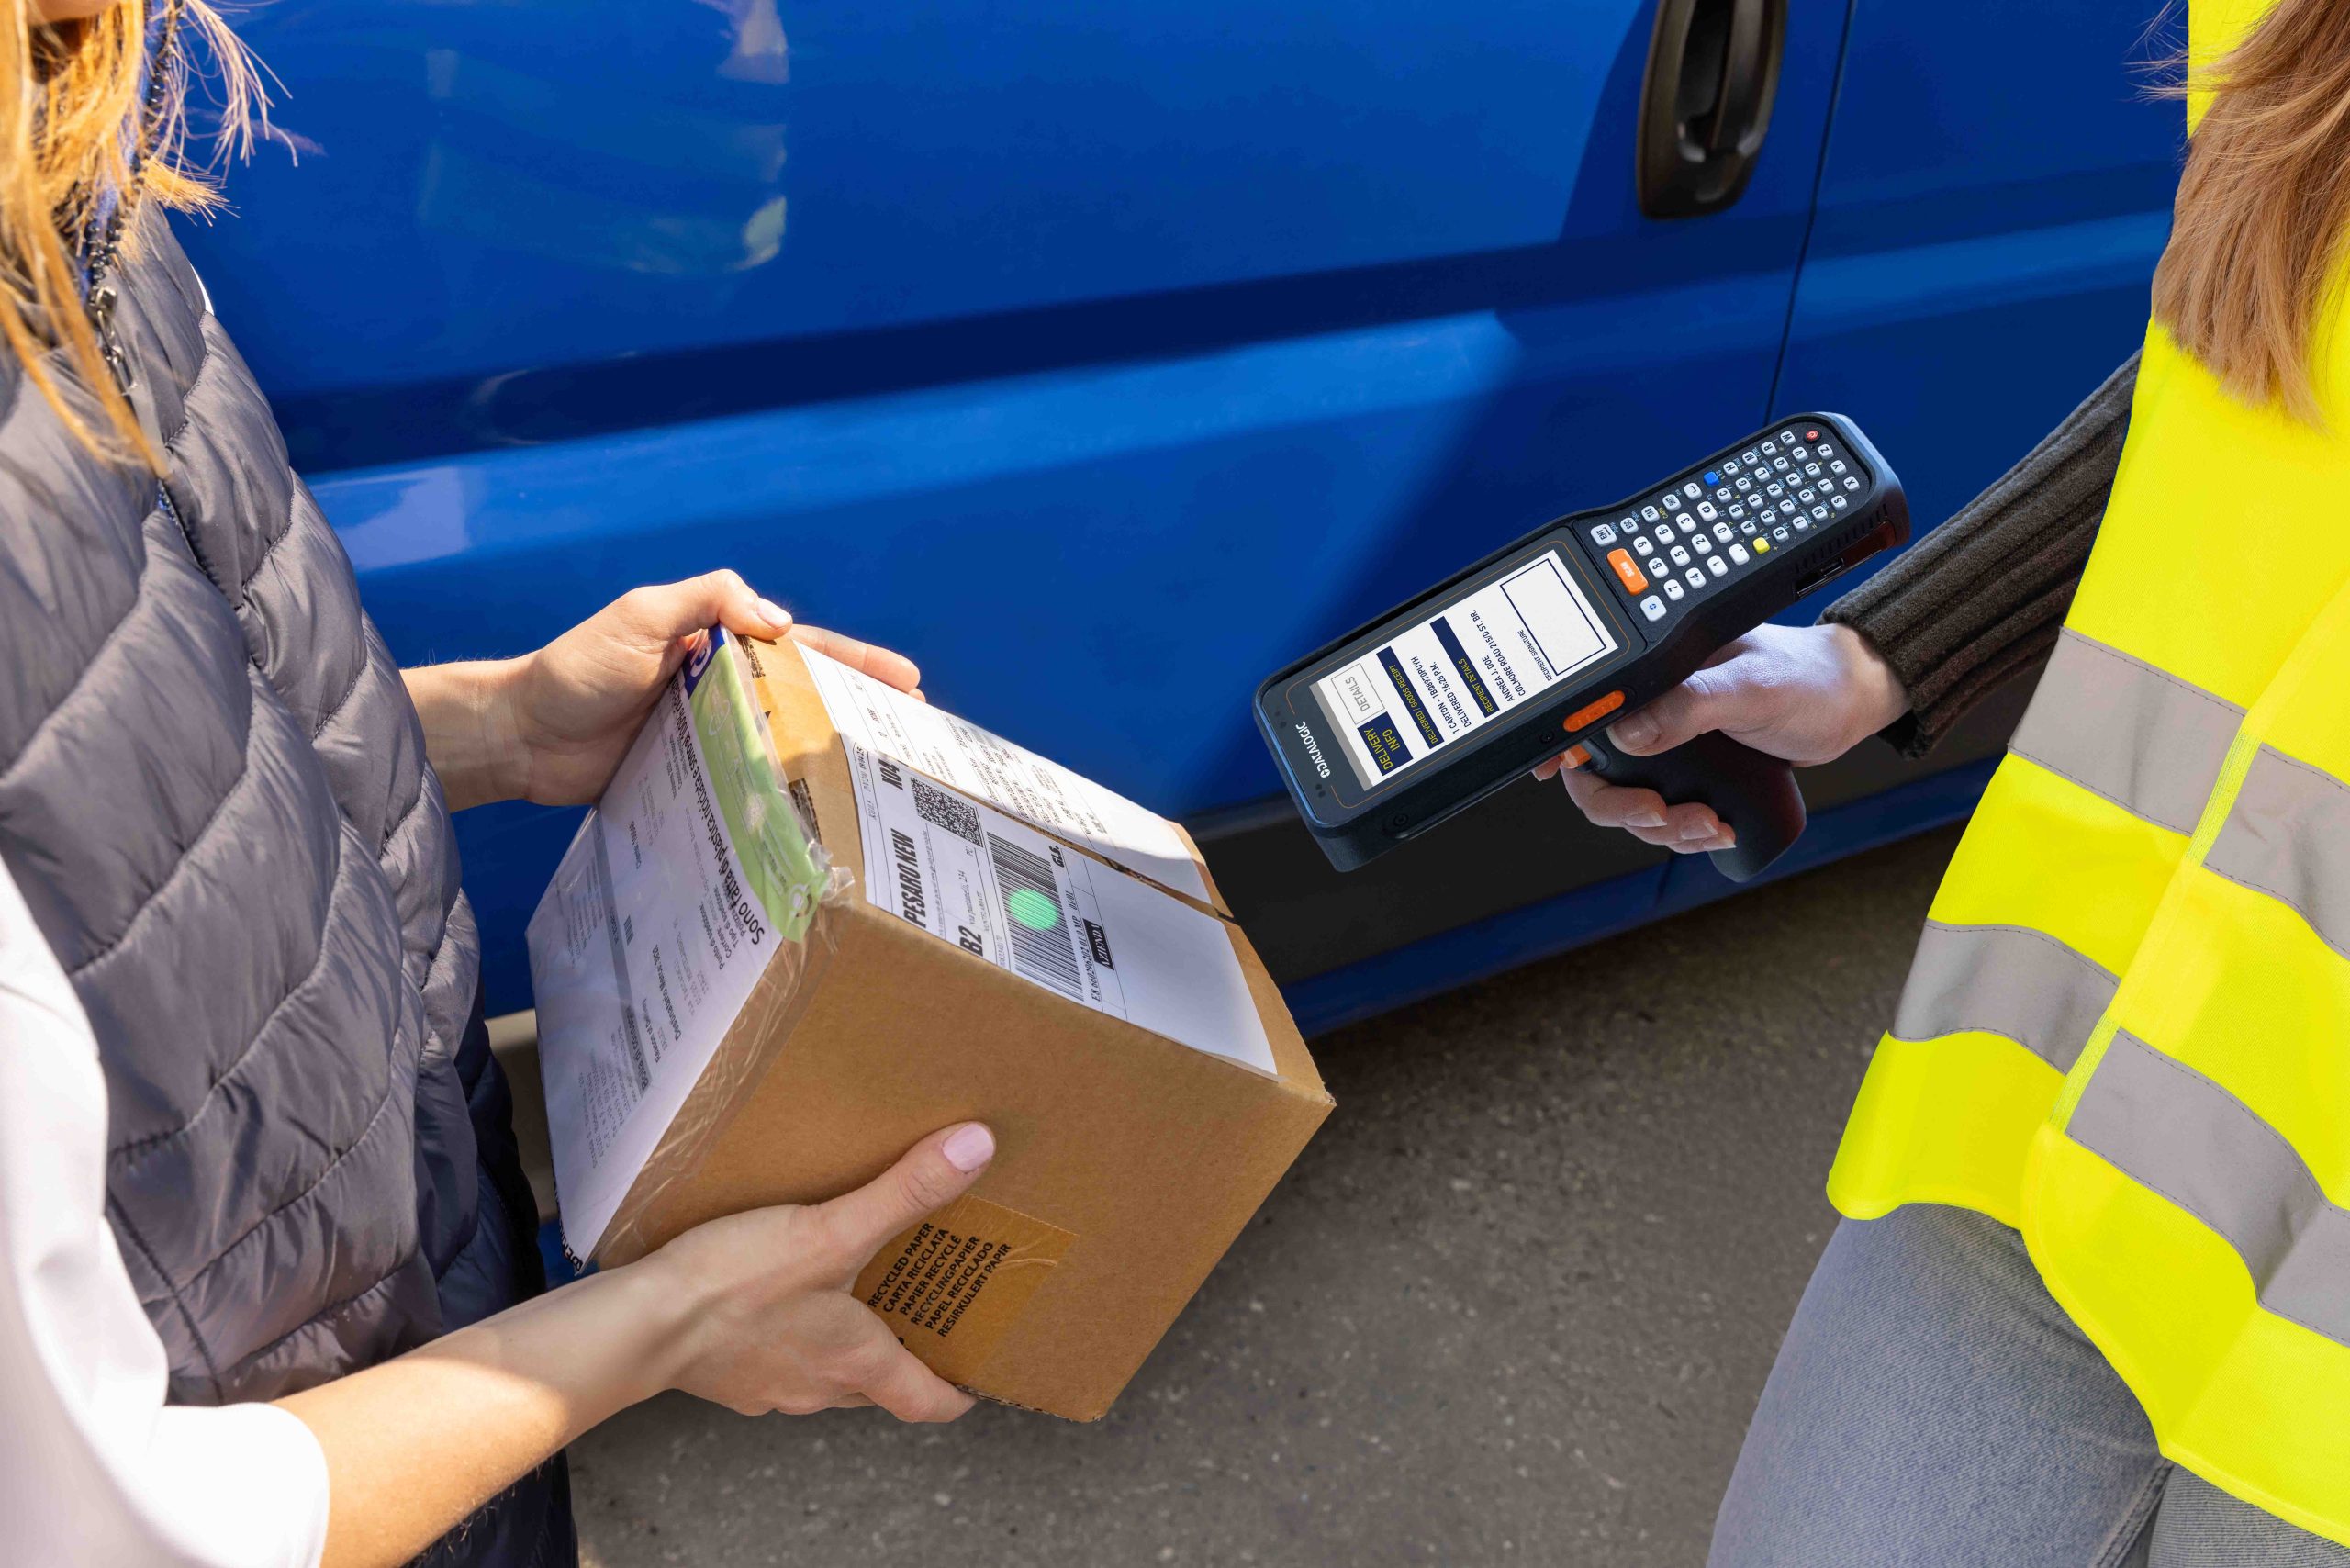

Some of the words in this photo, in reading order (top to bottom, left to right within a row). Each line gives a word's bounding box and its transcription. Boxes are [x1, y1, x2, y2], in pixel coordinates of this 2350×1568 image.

[1762, 443, 1773, 452] R
[1783, 432, 1793, 442] W
[1726, 463, 1736, 471] H
[1744, 453, 1755, 462] M
[1775, 458, 1785, 466] Q
[1645, 509, 1654, 518] TAB
[1658, 508, 1668, 519] CAPS
[1730, 506, 1740, 514] B
[1762, 511, 1773, 520] E
[1814, 508, 1824, 516] N
[1596, 530, 1607, 540] ENT
[1624, 520, 1633, 529] ESC
[1774, 528, 1785, 536] D
[1620, 561, 1635, 577] SCAN
[1471, 610, 1480, 622] BR.
[1477, 621, 1486, 631] ST.
[1483, 632, 1496, 648] 215/D
[1518, 630, 1538, 656] SIGNATURE
[1430, 662, 1441, 676] P.M.
[1483, 655, 1494, 669] DOE
[1493, 649, 1507, 666] ROAD
[1534, 656, 1552, 680] RECIPIENT
[1389, 665, 1406, 688] RECEIPT
[1459, 659, 1476, 682] DETAILS
[1504, 666, 1525, 696] COLMORE
[1346, 677, 1370, 711] DETAILS
[1438, 676, 1450, 692] 16:28
[1495, 676, 1514, 701] ANDREA
[1403, 688, 1417, 707] GOODS
[1447, 692, 1472, 727] DELIVERED
[1472, 683, 1494, 712] RECIPIENT
[1416, 711, 1438, 744] DELIVERED
[1438, 703, 1456, 728] CARTON
[1296, 722, 1327, 773] DATALOGIC
[1364, 728, 1393, 769] DELIVERY
[1382, 730, 1400, 751] INFO
[685, 740, 698, 772] sono
[877, 756, 904, 791] X04
[691, 772, 711, 823] riciclata
[703, 812, 728, 865] plastica
[890, 826, 919, 868] NEW
[718, 856, 729, 878] di
[722, 868, 742, 910] fatta
[895, 861, 927, 929] PESARO
[723, 919, 730, 932] di
[737, 899, 765, 948] Sono
[728, 926, 739, 948] Tipo
[957, 924, 983, 957] B2
[1091, 922, 1112, 968] AZIENDA
[662, 987, 681, 1041] Destinatario
[634, 1048, 641, 1063] di
[650, 1033, 661, 1063] Reason
[637, 1059, 649, 1091] Bolla
[867, 1257, 908, 1307] RECYCLED
[905, 1224, 934, 1256] PAPER
[883, 1281, 912, 1312] CARTA
[907, 1229, 948, 1279] RICICLATA
[900, 1275, 933, 1315] PAPIER
[924, 1236, 961, 1281] RECYCLÉ
[911, 1237, 979, 1325] RECYCLINGPAPIER
[925, 1301, 952, 1329] PAPEL
[947, 1243, 993, 1298] RECICLADO
[937, 1273, 987, 1337] RESIRKULERT
[984, 1244, 1011, 1273] PAPIR
